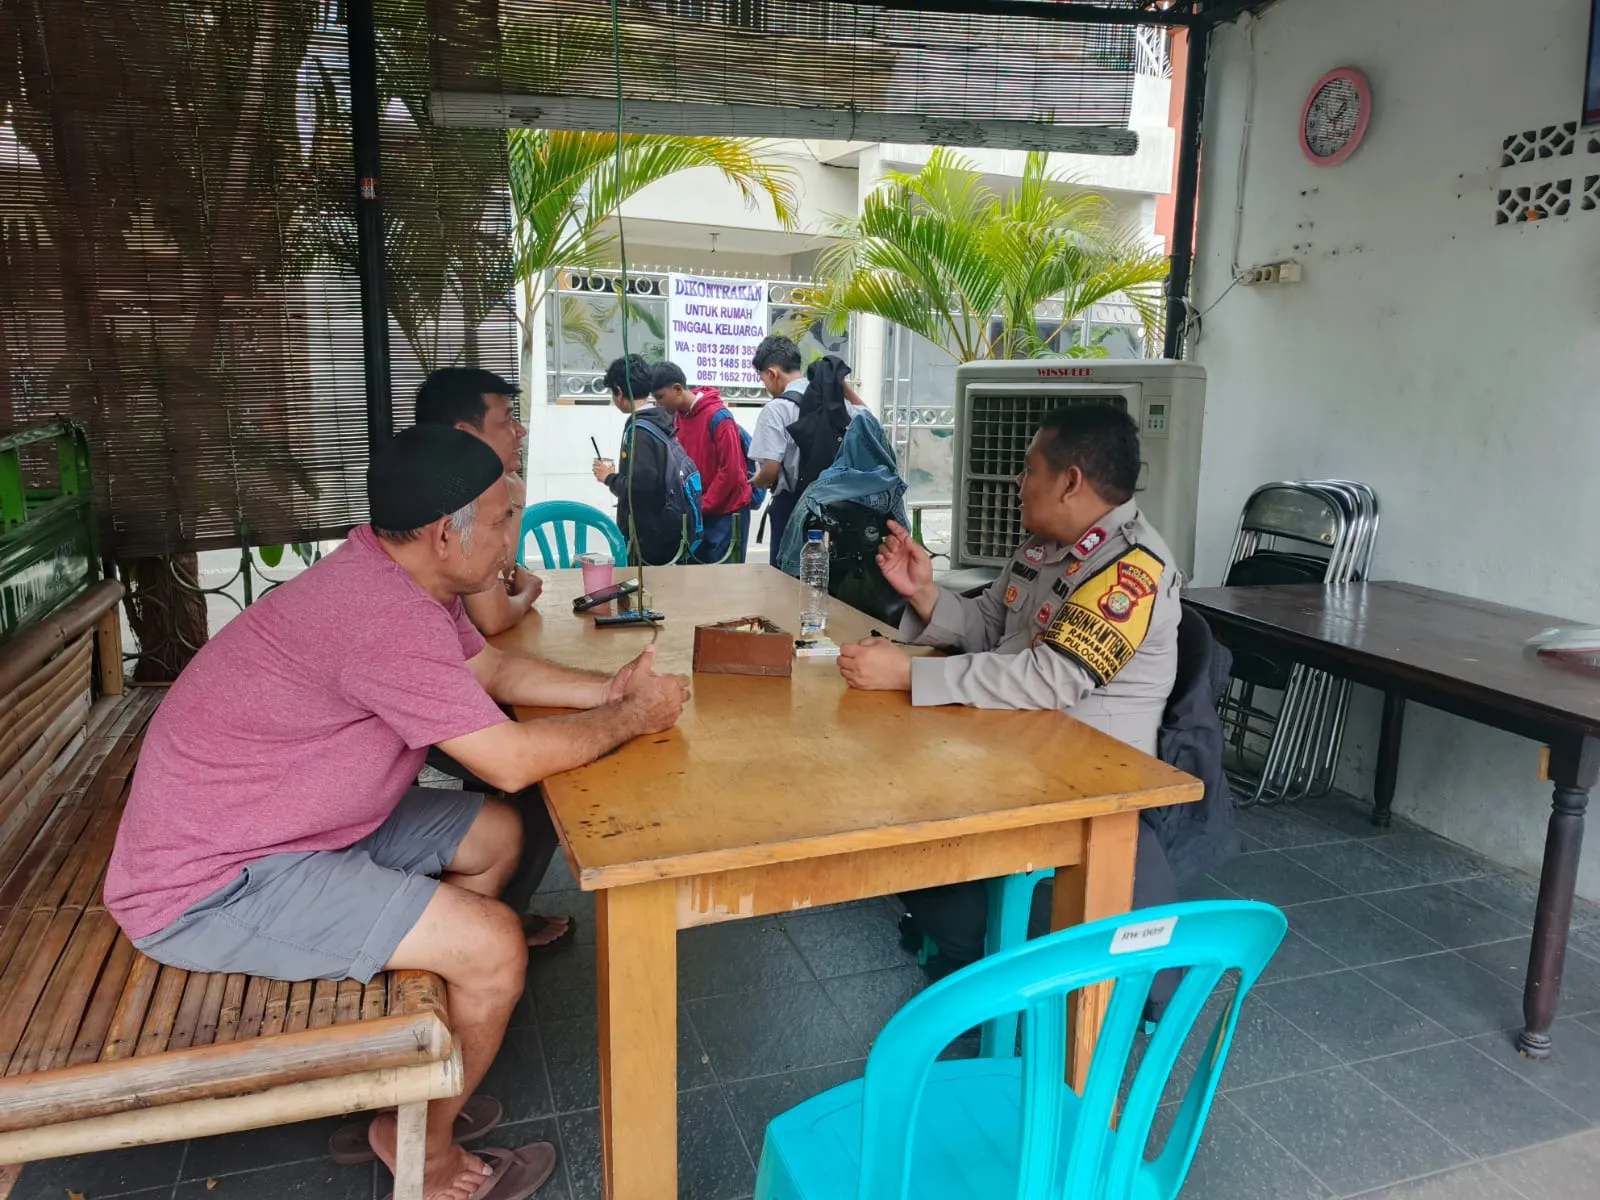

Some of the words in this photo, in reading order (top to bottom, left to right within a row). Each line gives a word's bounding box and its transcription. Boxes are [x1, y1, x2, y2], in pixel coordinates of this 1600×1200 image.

[675, 279, 762, 302] DIKONTRAKAN
[685, 304, 718, 318] UNTUK
[720, 307, 753, 319] RUMAH
[672, 320, 713, 334] TINGGAL
[715, 323, 764, 337] KELUARGA
[675, 341, 690, 352] WA
[697, 343, 718, 353] 0813
[720, 344, 739, 355] 2561
[741, 345, 757, 356] 383
[697, 356, 717, 367] 0813
[720, 358, 740, 369] 1485
[741, 359, 754, 369] 83
[697, 370, 717, 381] 0857
[720, 372, 740, 382] 1652
